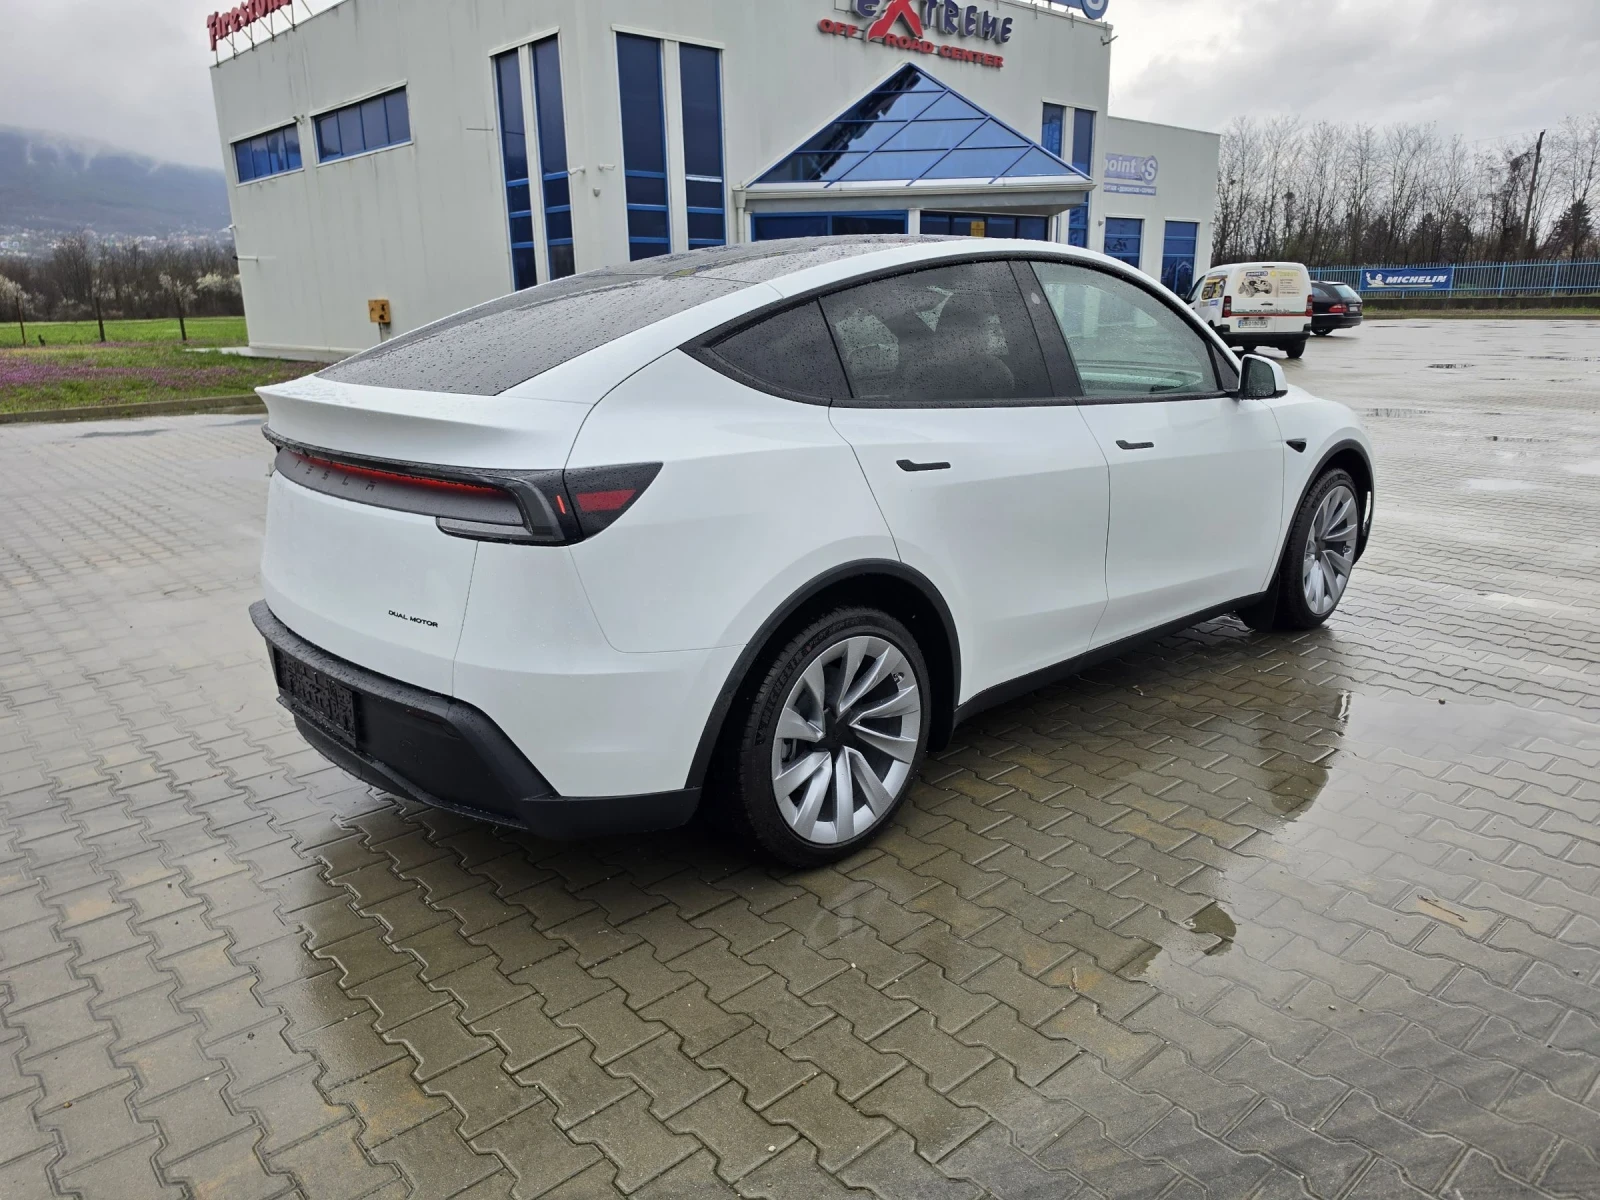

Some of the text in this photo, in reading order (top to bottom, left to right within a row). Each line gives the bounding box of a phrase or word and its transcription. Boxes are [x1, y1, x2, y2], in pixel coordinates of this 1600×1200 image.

[817, 18, 1004, 68] OFF ROAD CENTER
[1385, 275, 1448, 284] MICHELIN
[294, 460, 379, 492] TESLA
[388, 609, 438, 628] DUAL MOTOR
